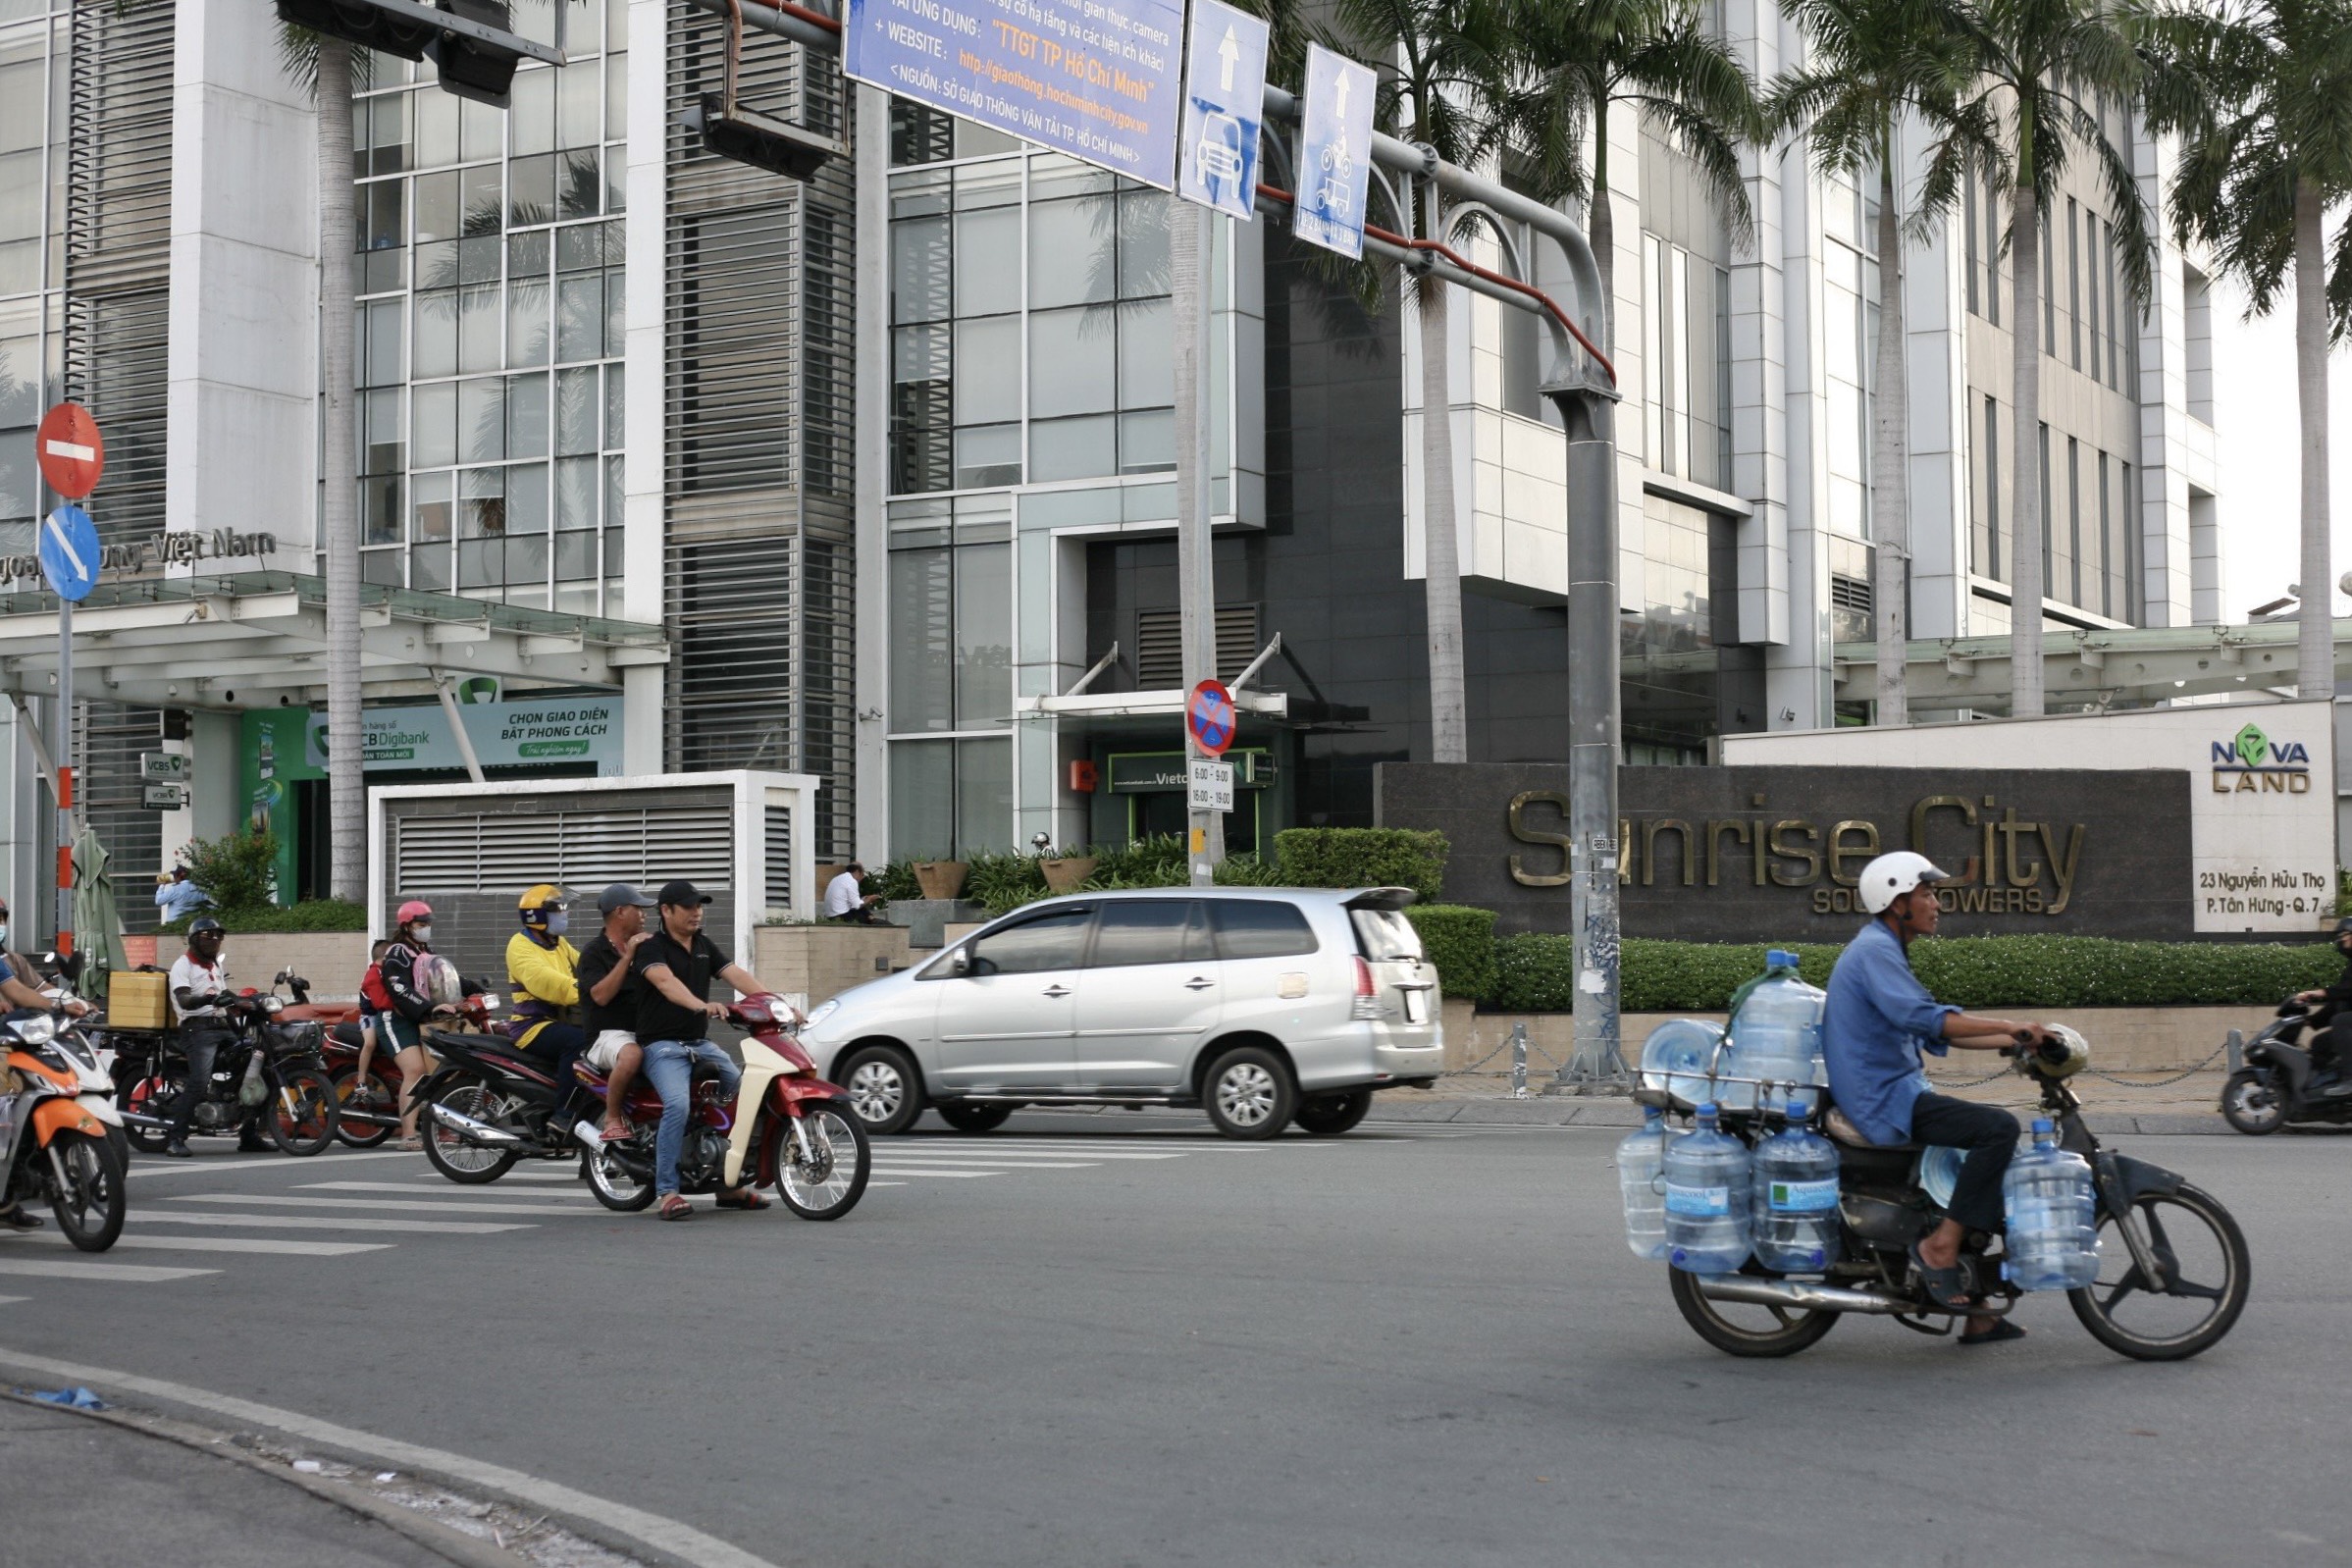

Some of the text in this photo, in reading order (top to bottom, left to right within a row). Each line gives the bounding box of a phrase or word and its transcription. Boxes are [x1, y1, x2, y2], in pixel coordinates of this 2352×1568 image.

[1084, 1, 1105, 18] gian
[1133, 21, 1169, 46] camera
[1028, 2, 1041, 26] hạ
[1044, 9, 1067, 36] tầng
[1069, 21, 1081, 38] và
[1083, 26, 1100, 46] các
[1102, 32, 1120, 56] tiện
[1123, 40, 1136, 60] ích
[1139, 48, 1165, 74] khác)
[1043, 40, 1062, 68] TP
[1066, 49, 1085, 78] Hồ
[1088, 58, 1111, 88] Chí
[943, 78, 958, 99] SỞ
[960, 86, 982, 109] GIAO
[986, 97, 1019, 122] THÔNG
[1021, 108, 1042, 131] VẬN
[1045, 115, 1060, 137] TẢI
[1092, 134, 1108, 151] CHÍ
[151, 529, 203, 566] Việt
[212, 526, 277, 557] Nam
[369, 721, 387, 731] hàng
[389, 720, 397, 729] số
[509, 712, 541, 726] CHỌN
[547, 710, 576, 723] GIAO
[362, 730, 430, 747] CB Digibank
[500, 722, 607, 741] BẬT PHONG CÁCH
[147, 760, 170, 771] VCBS
[1194, 767, 1208, 780] 6:00
[1216, 769, 1228, 783] 9:00
[1156, 772, 1188, 785] Vietc
[2213, 771, 2311, 793] LAND
[1193, 789, 1208, 803] 16:00
[1216, 791, 1230, 805] 19:00
[1911, 794, 2085, 914] City
[2200, 867, 2326, 892] 23 Nguyễn Hữu Thọ
